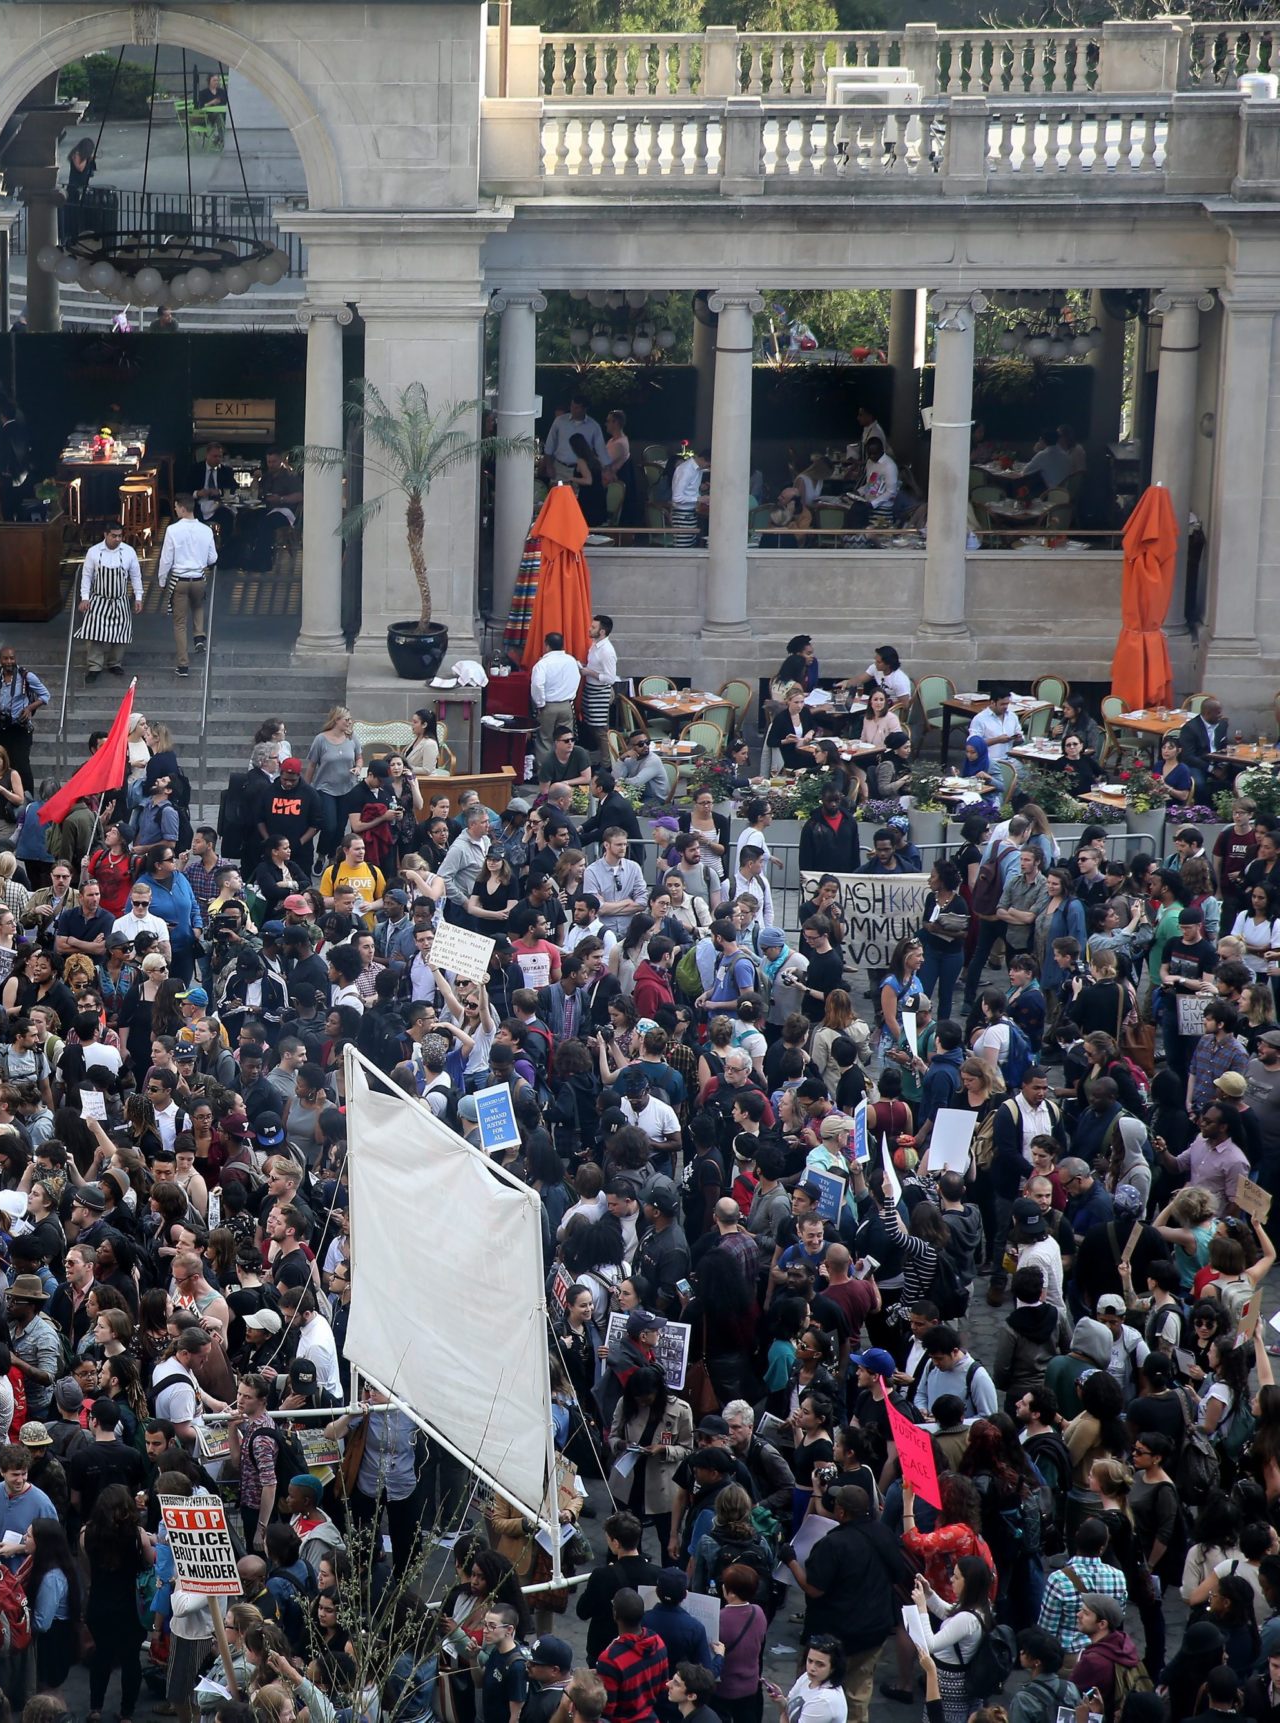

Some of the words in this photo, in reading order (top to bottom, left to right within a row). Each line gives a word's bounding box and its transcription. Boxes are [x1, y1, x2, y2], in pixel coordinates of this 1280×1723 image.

[215, 402, 249, 416] EXIT
[348, 879, 372, 888] LOVE
[805, 880, 886, 914] SASH
[843, 916, 920, 941] OMMUN
[1183, 1012, 1204, 1022] LIVE
[1180, 1022, 1205, 1034] MATT
[484, 1111, 507, 1123] DEMAND
[486, 1118, 507, 1129] JUSTICE
[492, 1127, 504, 1135] FOR
[893, 1417, 928, 1452] JUSTICE
[165, 1510, 221, 1528] STOP
[169, 1530, 231, 1546] POLICE
[173, 1546, 231, 1562] BRUTALITY
[178, 1562, 186, 1577] &
[187, 1563, 237, 1579] MURDER
